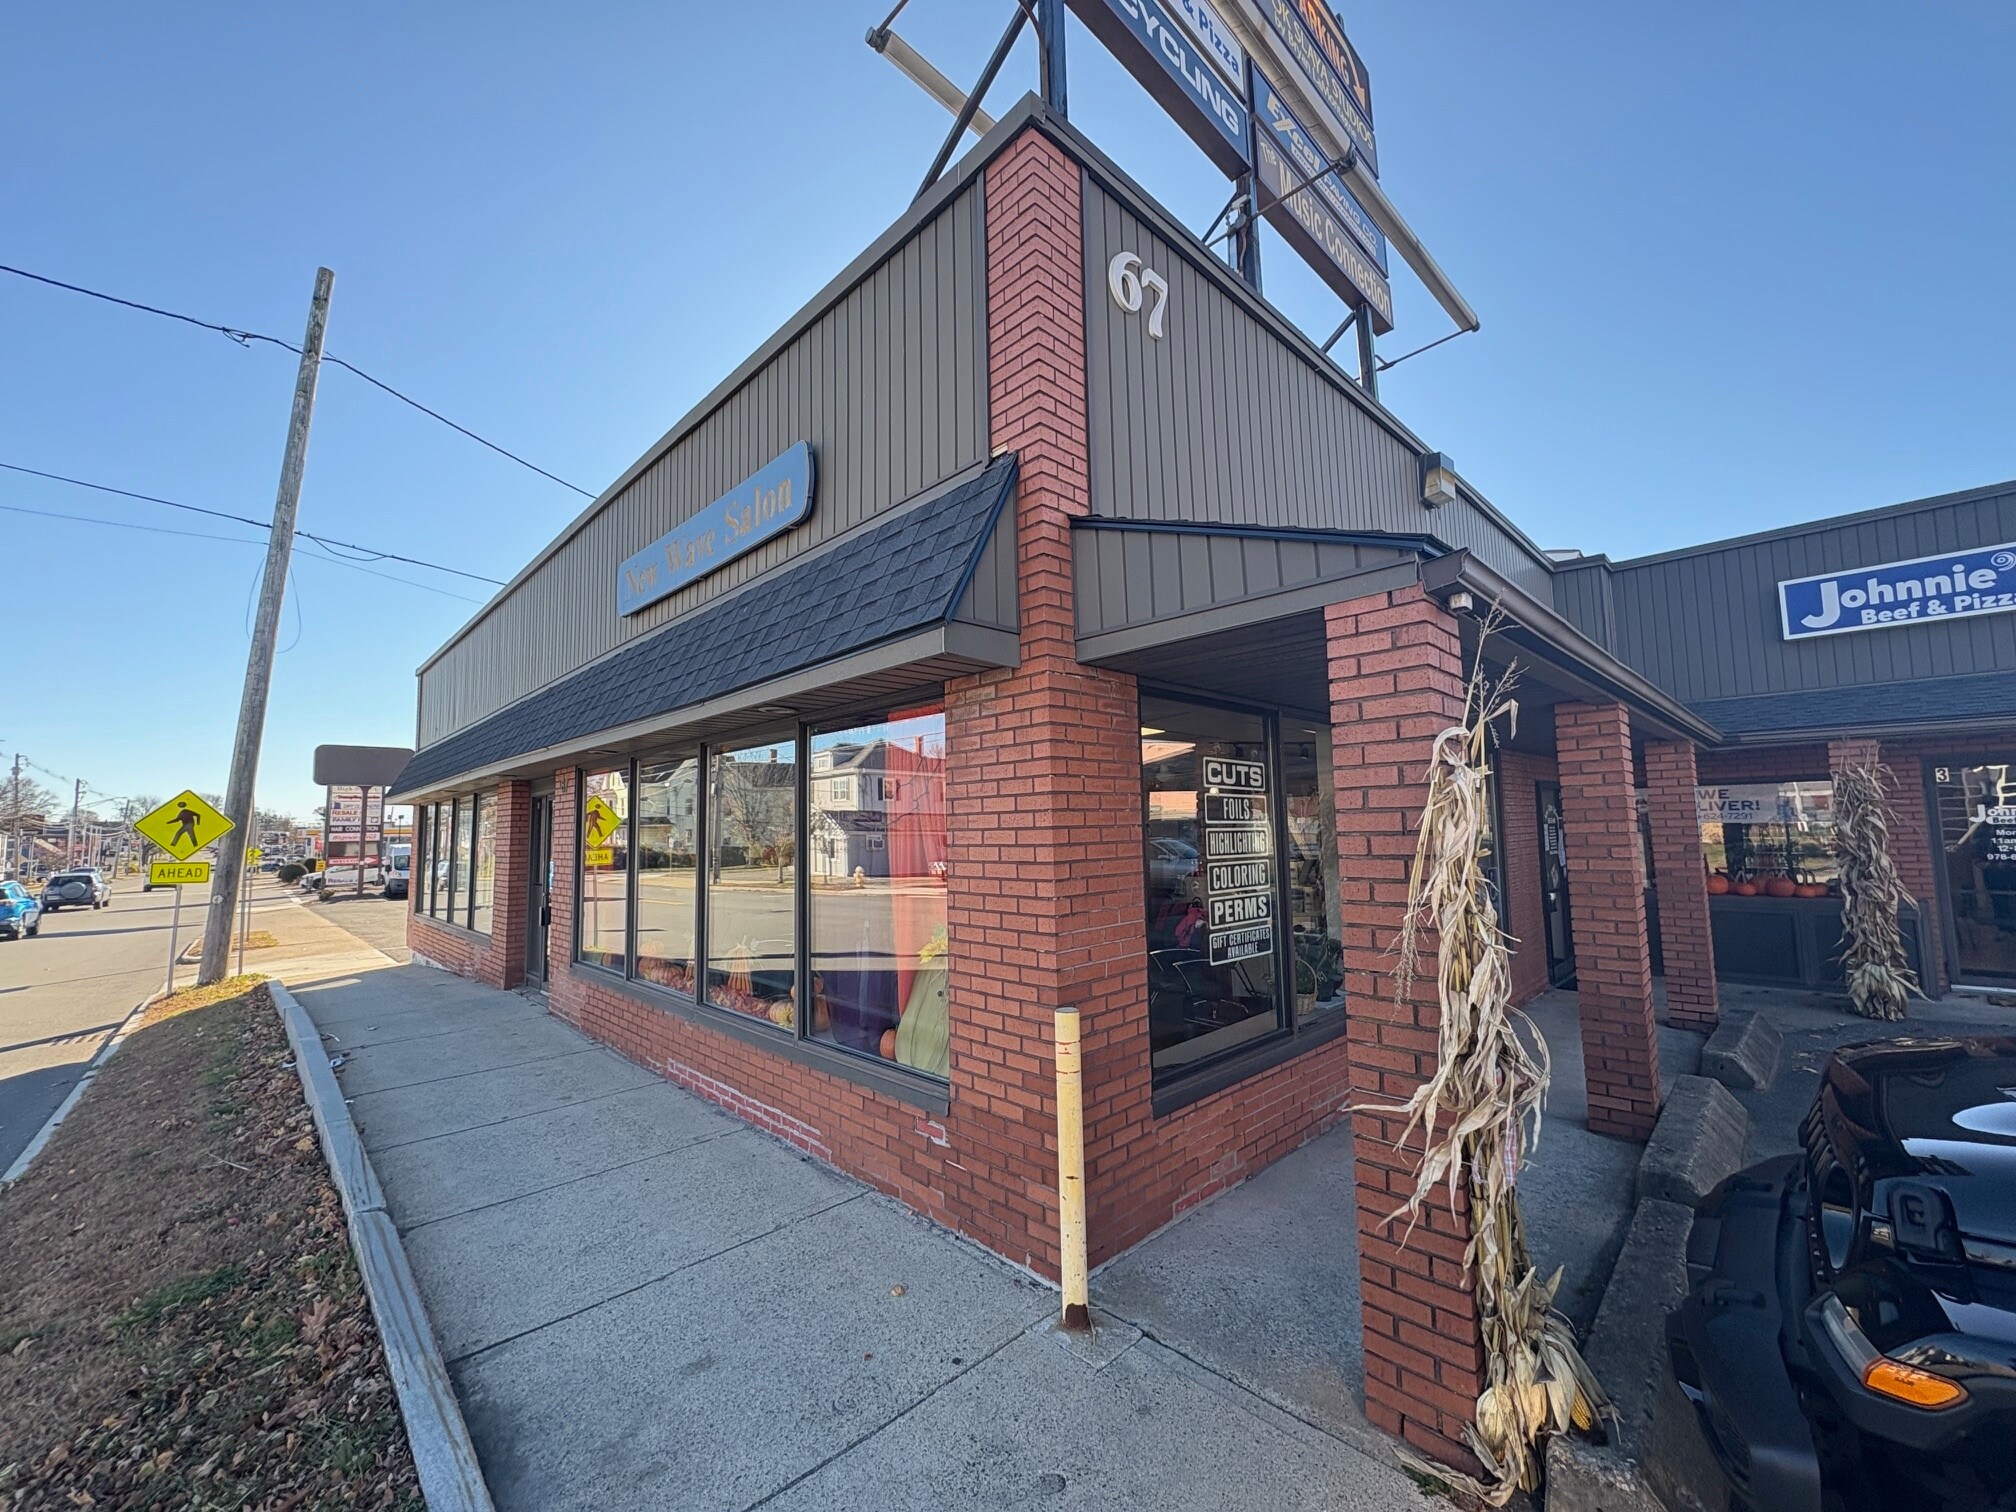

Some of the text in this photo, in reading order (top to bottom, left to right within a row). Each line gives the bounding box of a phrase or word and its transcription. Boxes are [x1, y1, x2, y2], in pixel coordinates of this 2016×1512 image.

[1198, 6, 1240, 77] Pizza
[1331, 78, 1374, 150] STUDIOS
[1260, 141, 1277, 166] The
[1323, 174, 1360, 224] PAVING
[1279, 160, 1323, 241] Music
[1325, 217, 1391, 320] Connection
[1108, 251, 1169, 340] 67
[625, 477, 792, 600] New Wave Salon
[1801, 564, 1998, 629] Johnnie
[1860, 592, 2016, 625] Beef & Pizz
[1207, 762, 1263, 787] CUTS
[1936, 768, 1948, 782] 3
[1697, 788, 1730, 799] WE
[1223, 798, 1250, 820] FOILS
[1209, 831, 1266, 855] HIGHLIGHTING
[157, 867, 203, 879] AHEAD
[1212, 863, 1266, 890] COLORING
[1213, 896, 1268, 925] PERMS
[1212, 927, 1270, 949] GIFT CERTIFICATES
[1227, 941, 1259, 959] AVAILABLE
